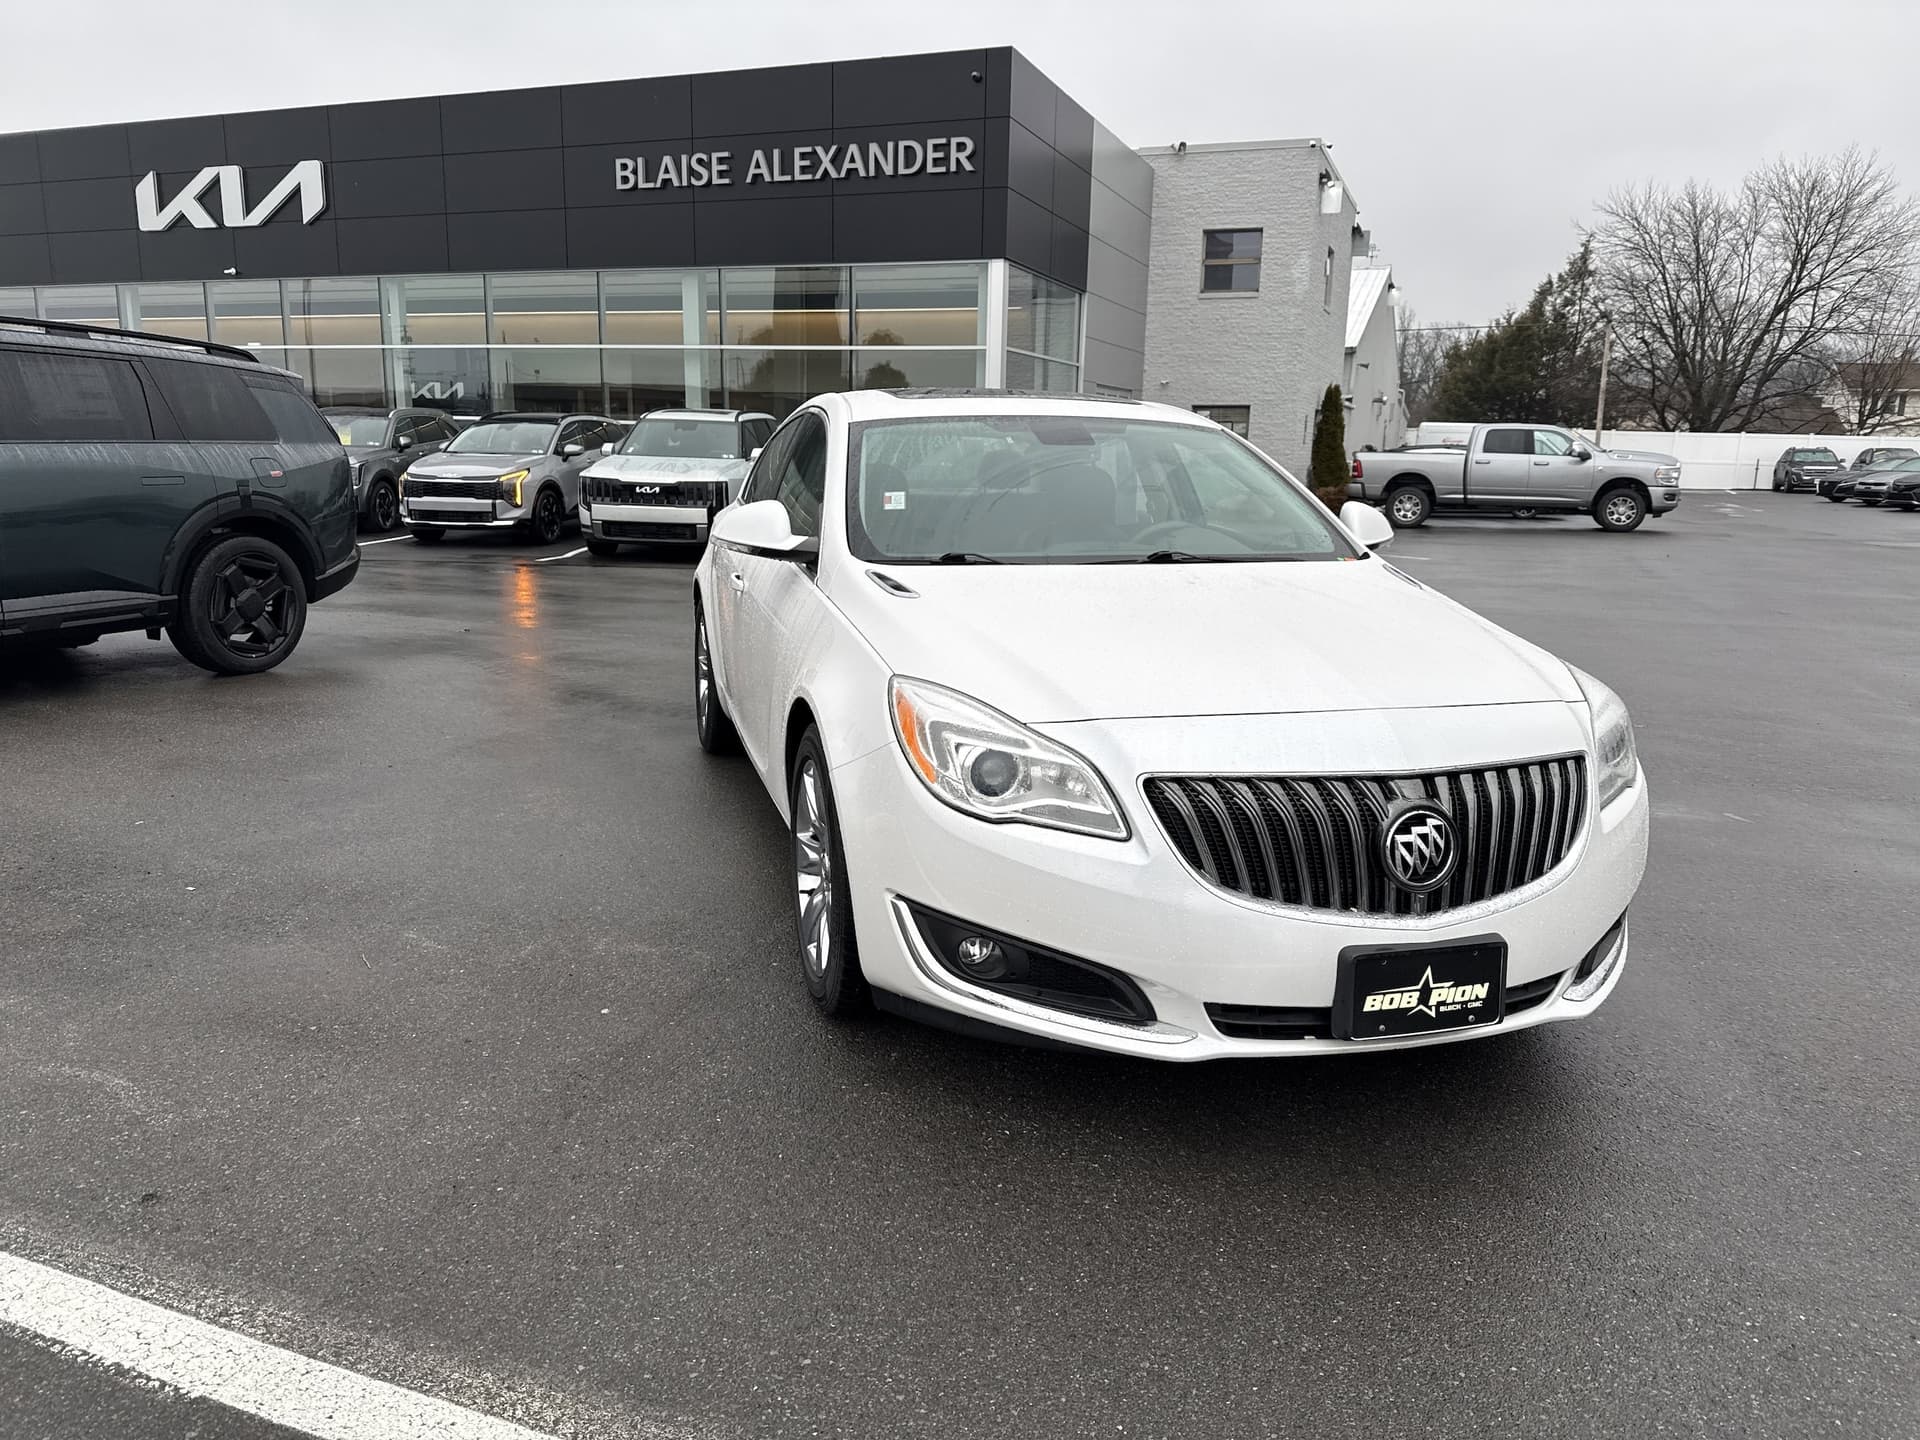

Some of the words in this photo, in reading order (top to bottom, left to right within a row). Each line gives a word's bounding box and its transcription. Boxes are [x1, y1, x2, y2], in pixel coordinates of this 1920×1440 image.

[614, 151, 732, 190] BLAISE
[745, 136, 976, 183] ALEXANDER
[135, 159, 326, 232] KIA
[1363, 991, 1420, 1012] BOB
[1428, 982, 1490, 1006] PION
